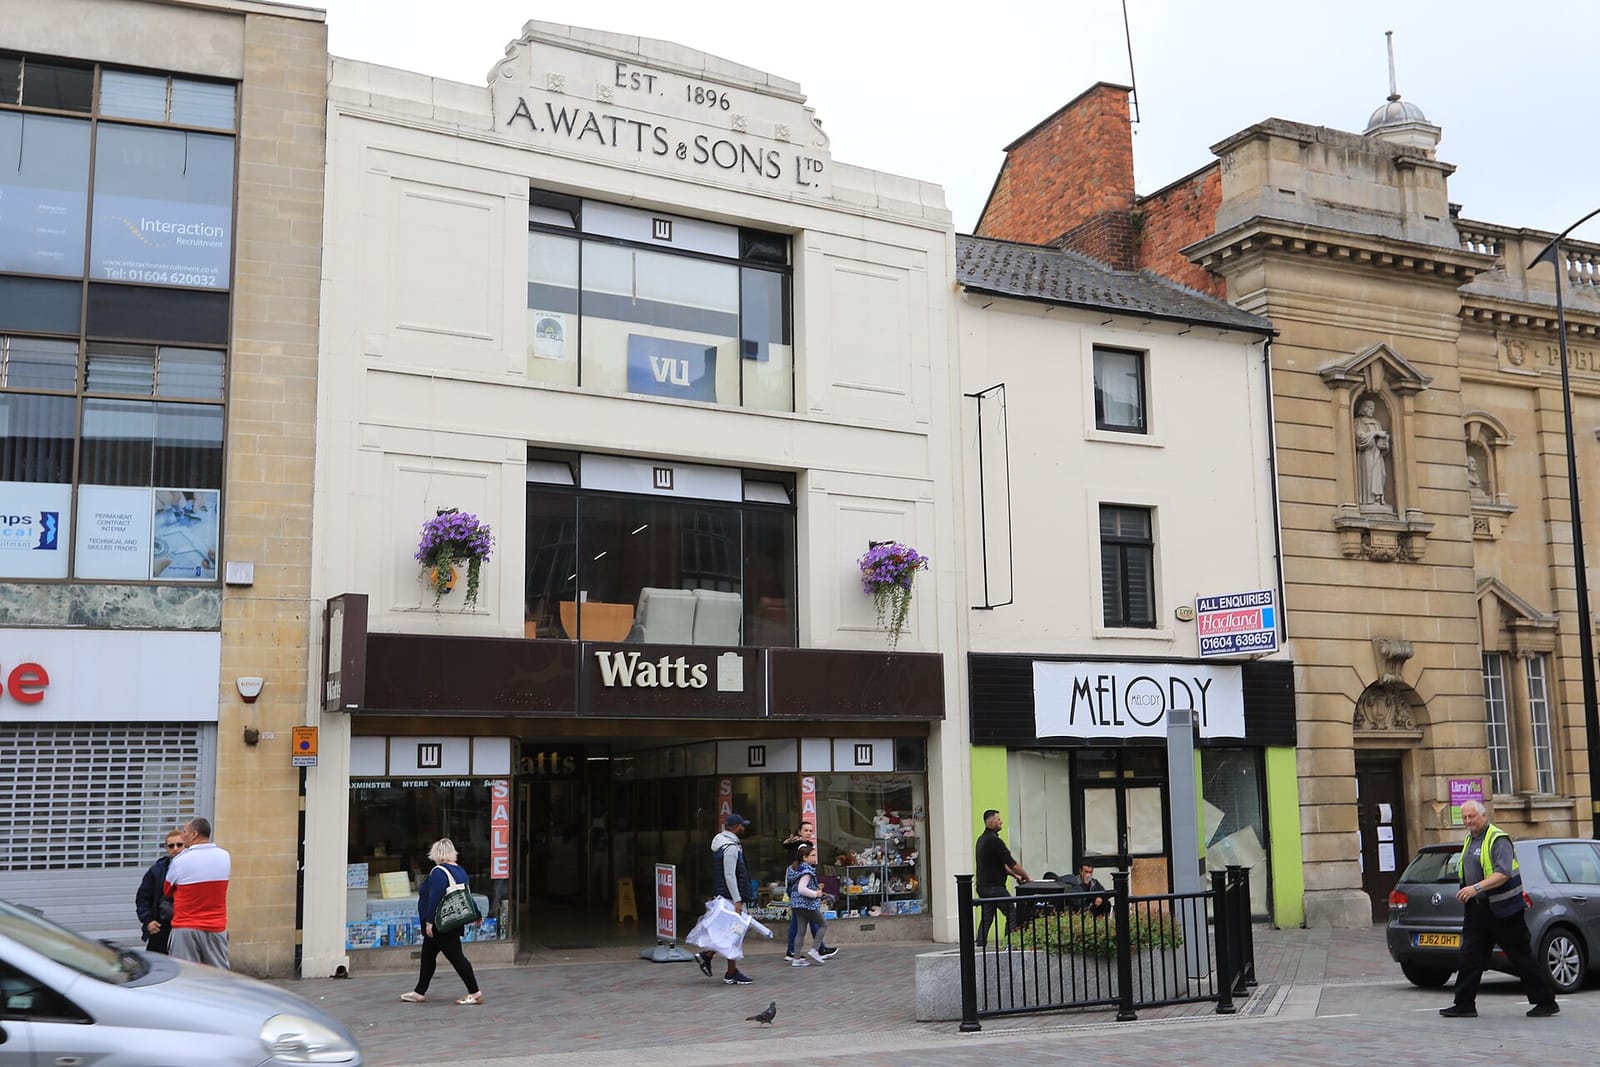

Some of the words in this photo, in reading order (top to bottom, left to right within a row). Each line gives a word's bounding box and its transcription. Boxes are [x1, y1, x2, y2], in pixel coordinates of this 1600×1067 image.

[615, 63, 664, 96] EST.
[686, 84, 731, 111] 1896
[675, 142, 688, 160] &
[694, 135, 782, 180] SONS
[141, 218, 224, 238] Interaction
[176, 238, 222, 248] Recruitment
[104, 268, 126, 279] Tel:
[129, 269, 168, 282] 01604
[170, 272, 216, 286] 620032
[1200, 598, 1218, 611] ALL
[1220, 592, 1271, 608] ENQUIRIES
[1201, 610, 1260, 630] Hadland
[1202, 636, 1232, 650] 01604
[1235, 632, 1274, 646] 639657
[594, 651, 708, 688] Watts
[1070, 675, 1212, 727] MELODY
[1130, 694, 1160, 706] MELODY
[517, 752, 576, 776] atts
[494, 780, 509, 874] SALE
[658, 873, 673, 886] SALE
[658, 896, 673, 910] SALE
[658, 918, 673, 932] SALE
[1419, 935, 1439, 944] BJ62
